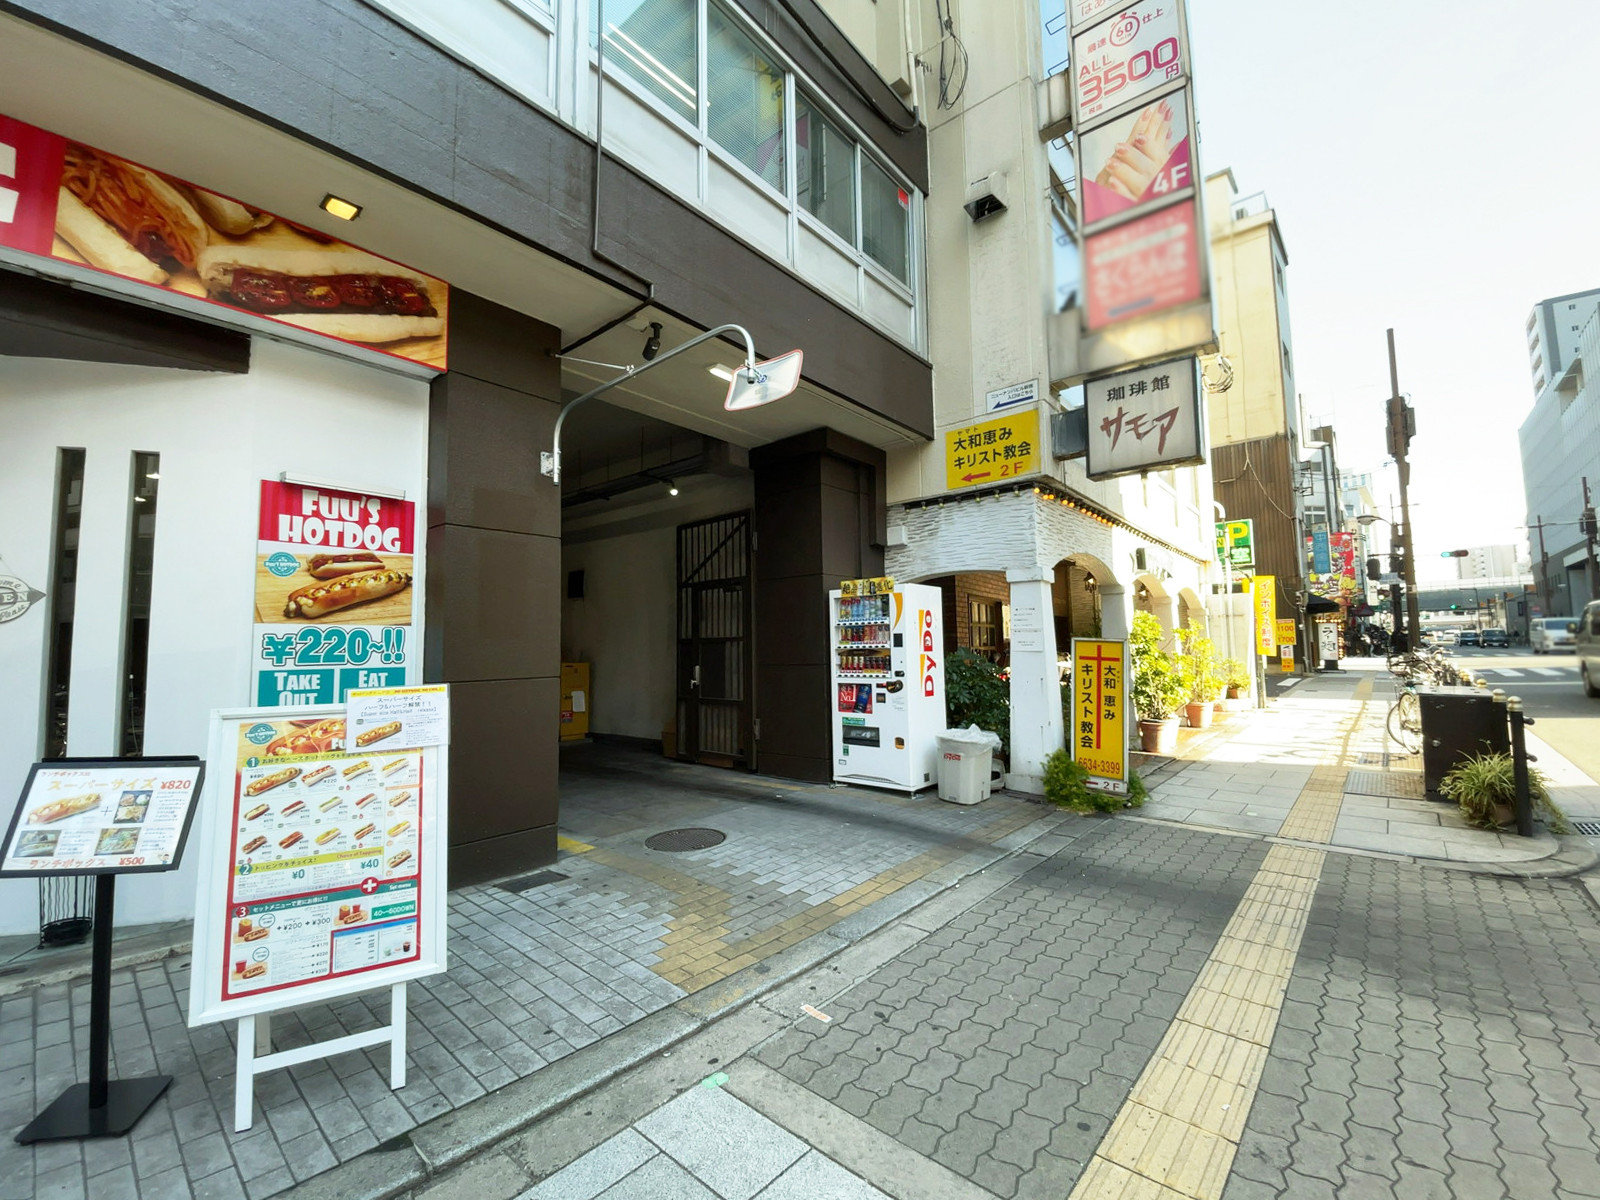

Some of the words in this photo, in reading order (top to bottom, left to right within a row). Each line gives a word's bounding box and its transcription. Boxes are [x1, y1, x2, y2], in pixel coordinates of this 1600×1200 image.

[1116, 21, 1133, 37] 60
[1080, 54, 1112, 79] ALL
[1080, 37, 1178, 108] 3500
[1165, 63, 1179, 79] 円
[1153, 163, 1188, 194] 4F
[1107, 375, 1170, 402] 珈琲館
[1100, 406, 1180, 456] サモア
[953, 427, 1013, 453] 大和恵み
[953, 441, 1031, 470] キリスト教会
[1000, 461, 1024, 477] 2F
[302, 489, 381, 524] FUU'S
[278, 514, 401, 553] HOTDOG
[1227, 522, 1249, 547] P
[274, 672, 321, 691] TAKE
[358, 670, 389, 688] EAT
[279, 691, 319, 706] OUT
[377, 694, 422, 703] スーパーサイズ
[1080, 664, 1094, 750] キリスト教会
[47, 777, 158, 791] スーパーサイズ
[160, 780, 192, 790] ¥820
[1103, 781, 1120, 791] 2F
[29, 858, 106, 869] ランチボックス
[118, 856, 145, 866] ¥500
[360, 858, 380, 870] ¥40
[242, 865, 250, 875] 2
[292, 868, 305, 880] ¥0
[239, 906, 247, 917] 3
